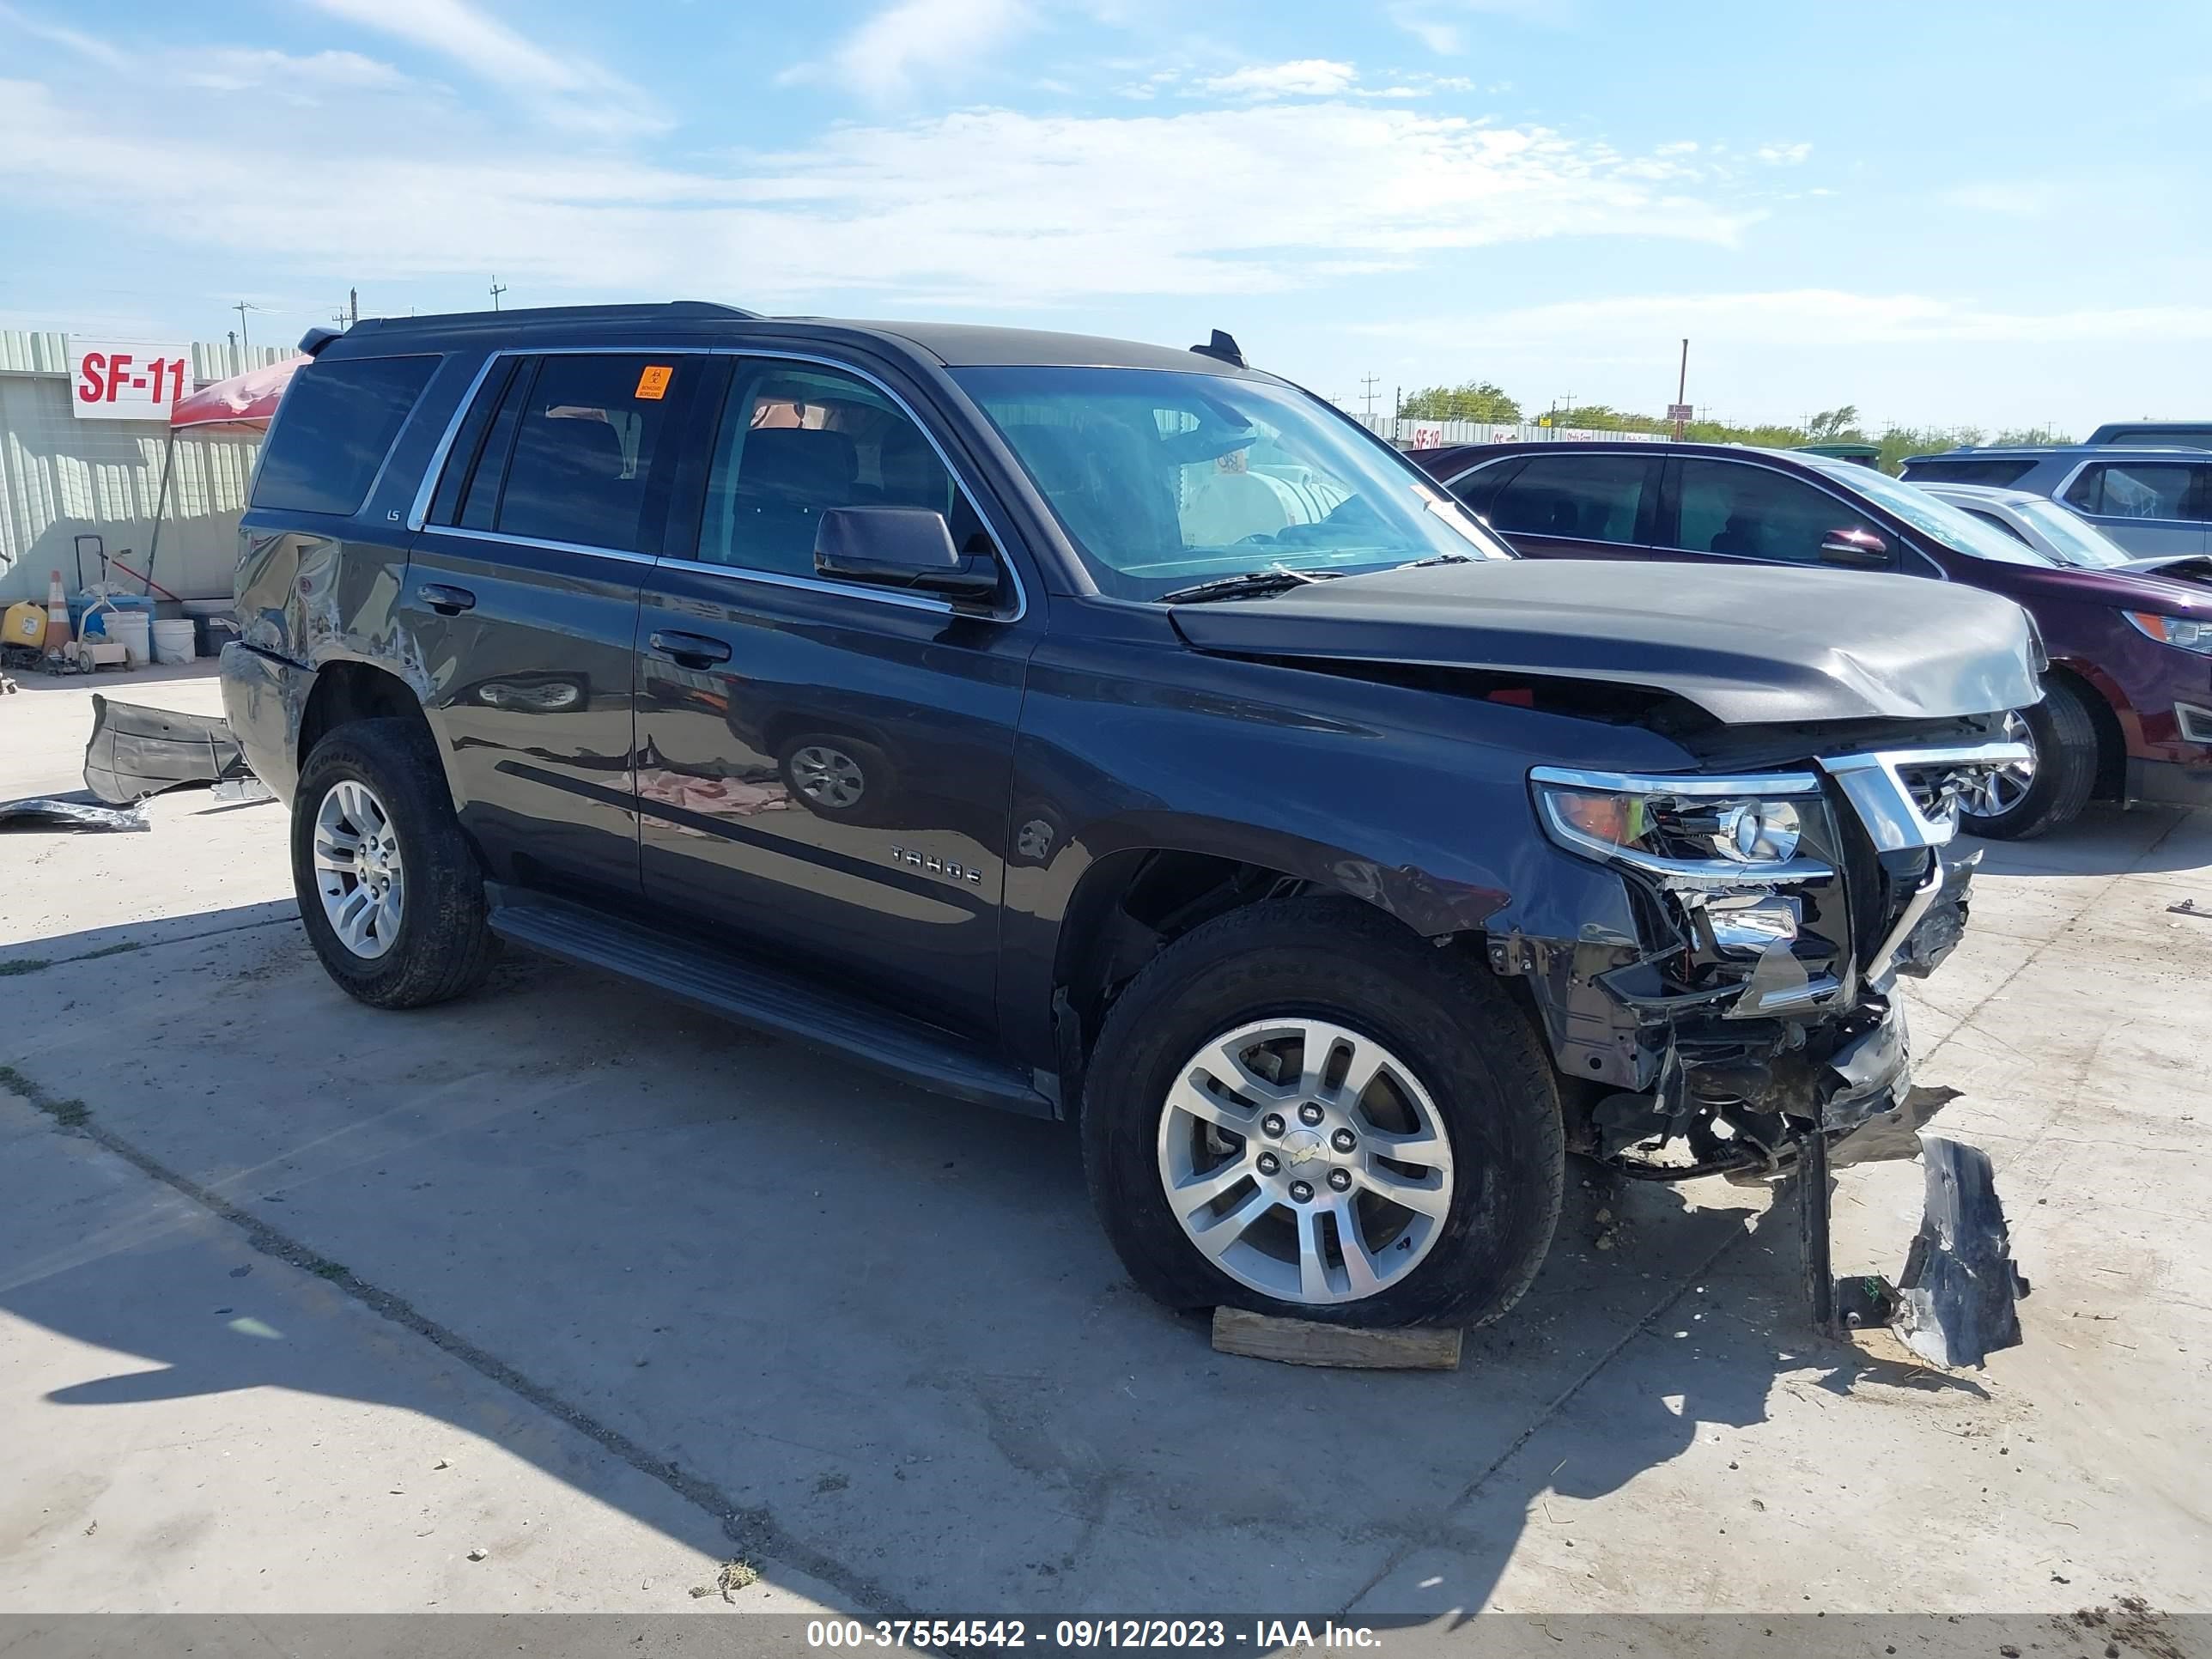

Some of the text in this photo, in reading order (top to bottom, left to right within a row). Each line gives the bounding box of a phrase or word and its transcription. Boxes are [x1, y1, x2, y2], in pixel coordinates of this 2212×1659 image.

[78, 352, 185, 404] SF-11
[1414, 428, 1440, 450] SF-18
[386, 509, 401, 521] LS
[890, 844, 982, 886] TAHOE
